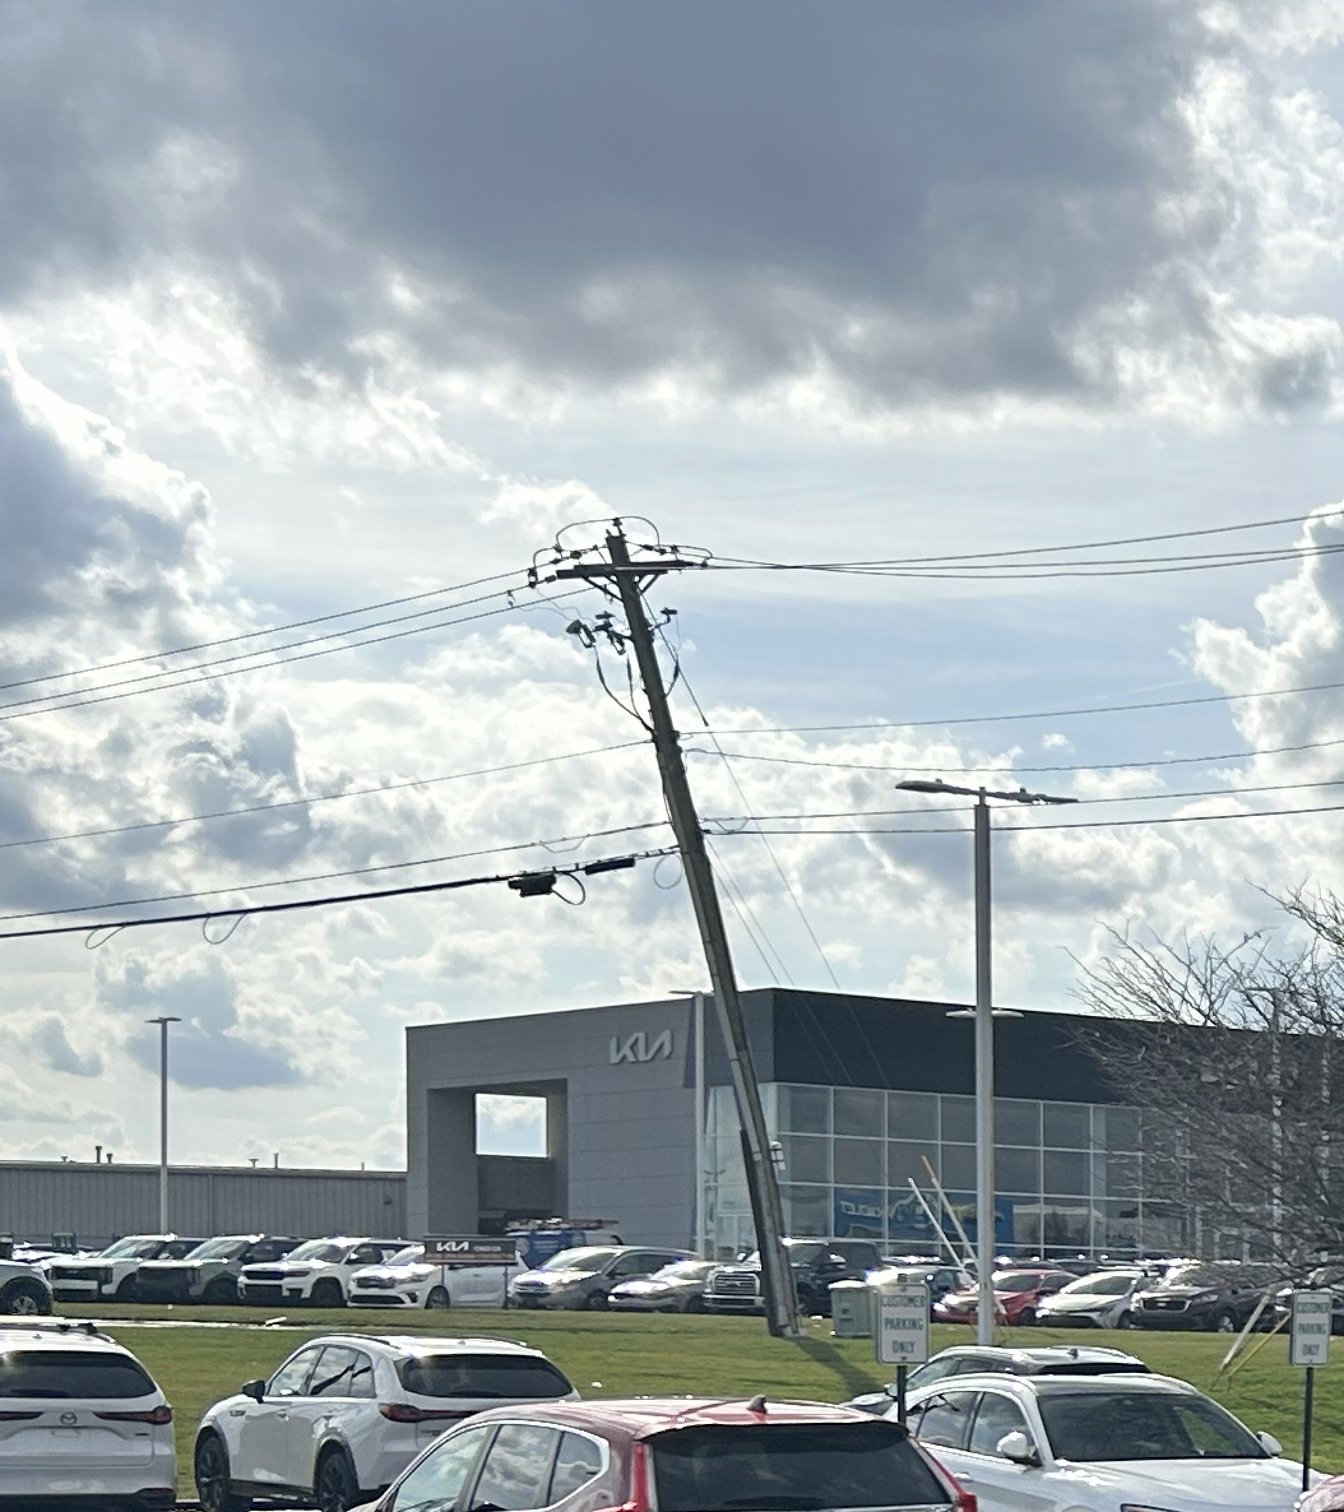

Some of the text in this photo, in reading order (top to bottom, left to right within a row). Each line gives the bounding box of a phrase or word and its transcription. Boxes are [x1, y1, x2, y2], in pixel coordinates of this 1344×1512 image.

[610, 1030, 672, 1064] KIA
[884, 1317, 924, 1330] PARKING
[892, 1340, 916, 1353] ONLY
